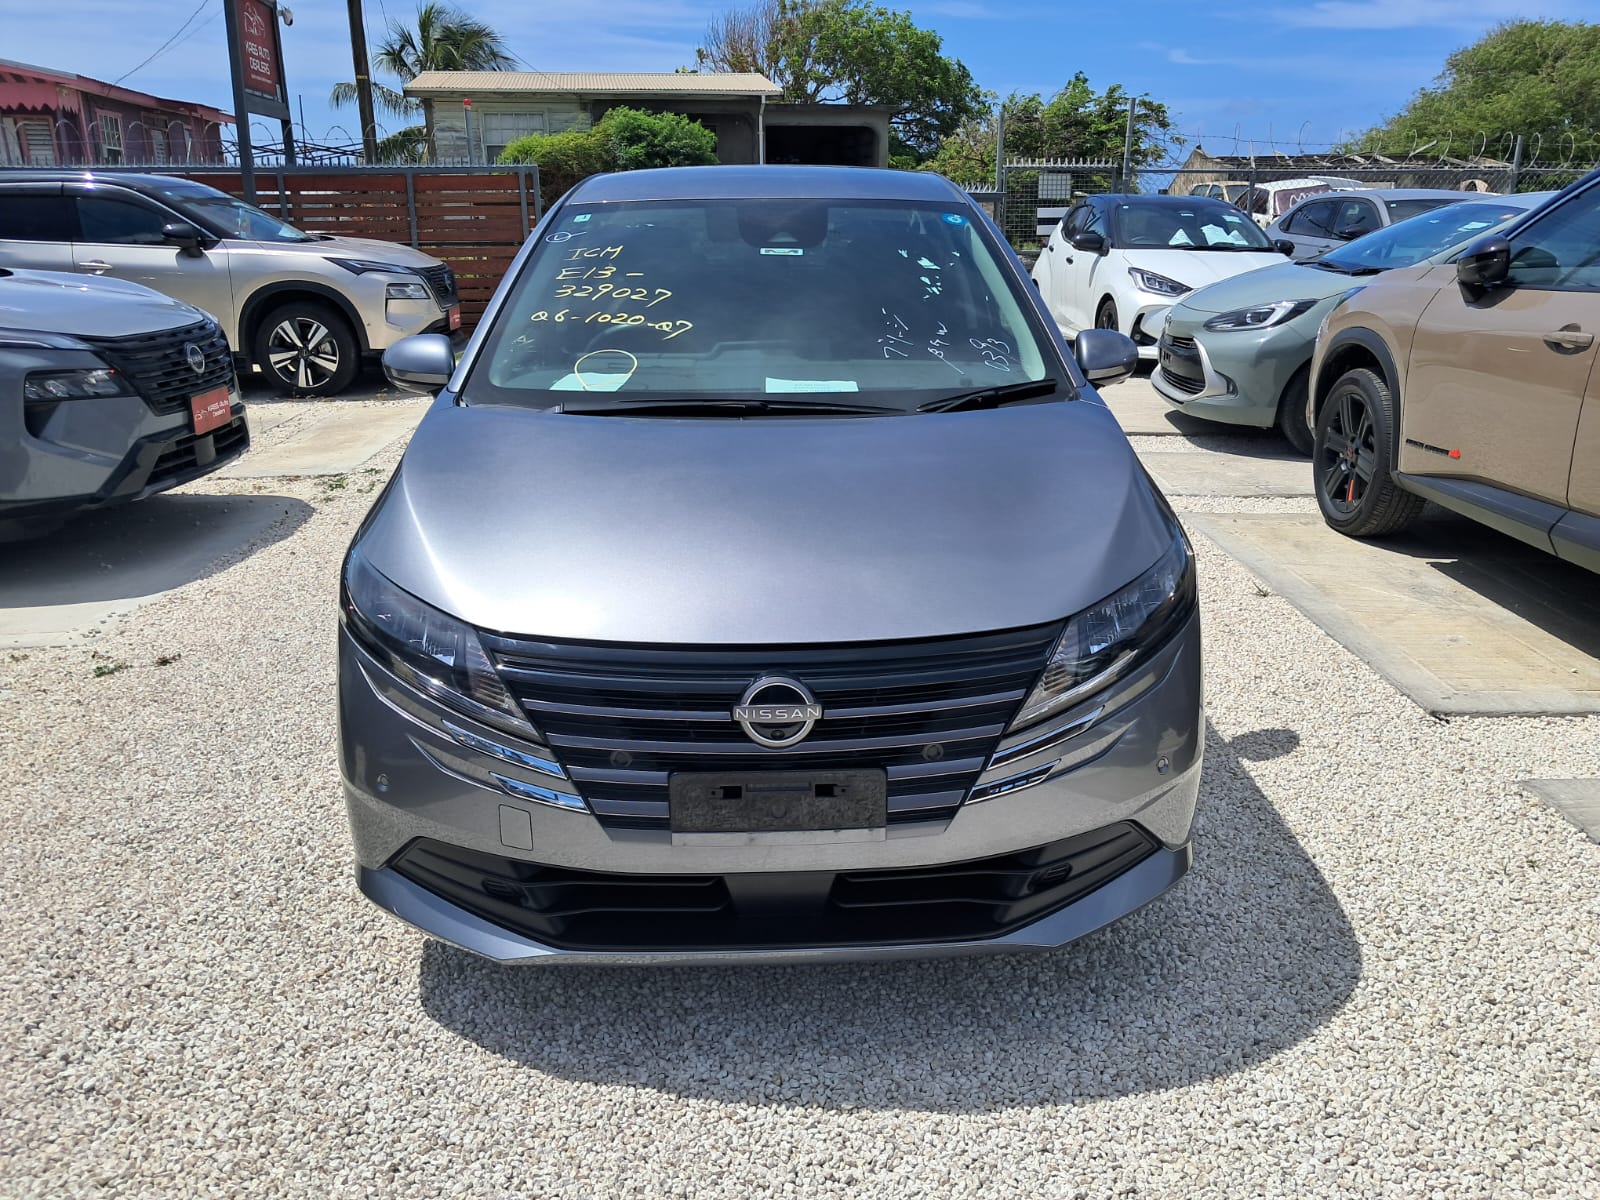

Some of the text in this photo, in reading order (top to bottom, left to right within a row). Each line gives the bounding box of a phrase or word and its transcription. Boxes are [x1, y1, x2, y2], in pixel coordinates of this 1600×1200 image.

[249, 57, 271, 75] DEALERS
[563, 245, 624, 261] ICM
[554, 283, 673, 308] 329027
[735, 706, 820, 720] NISSAN
